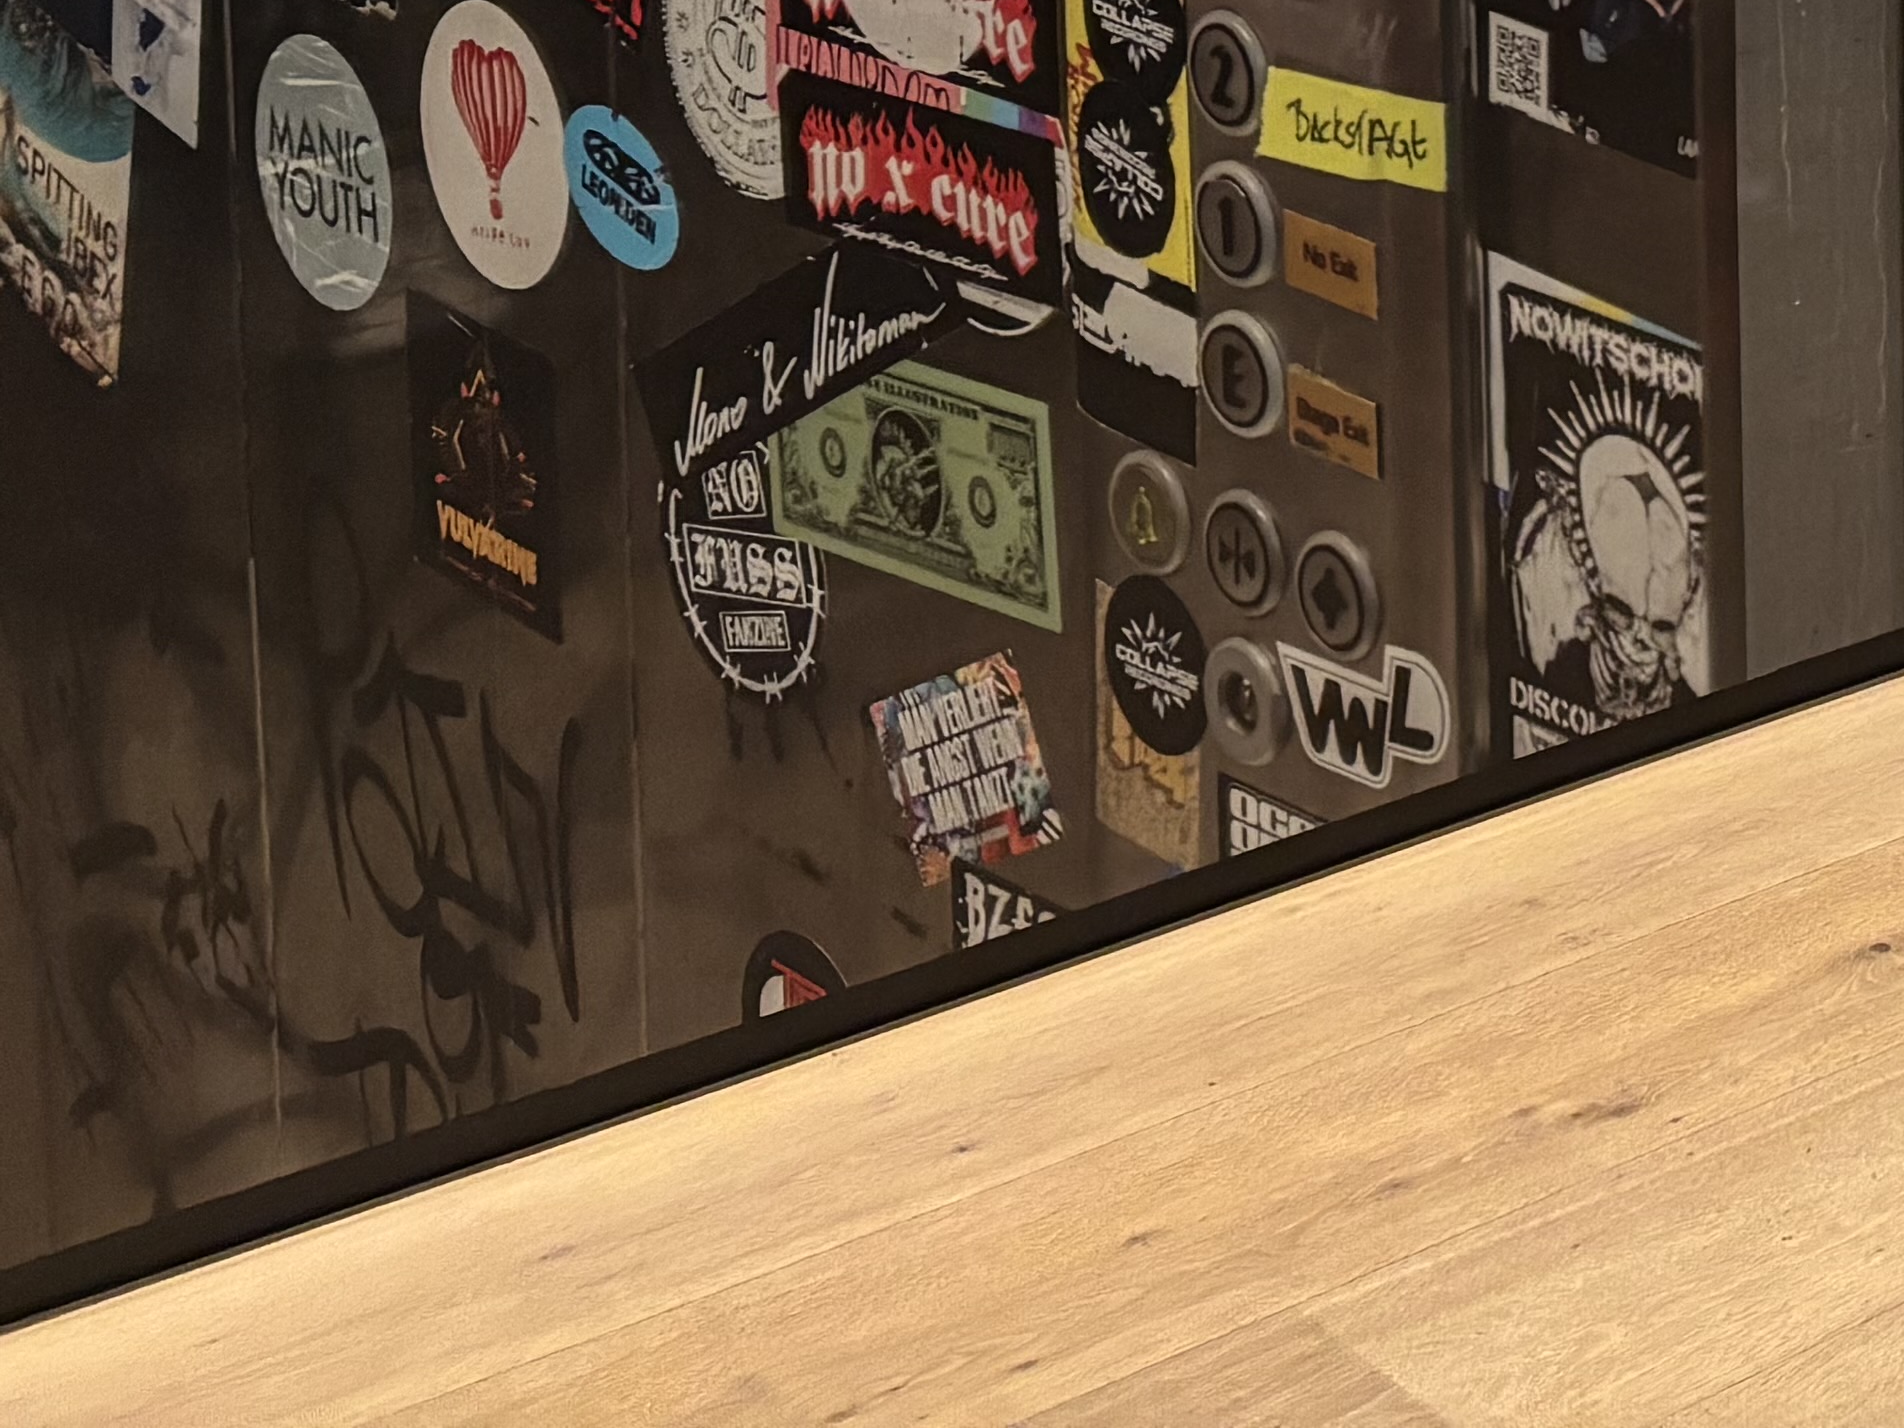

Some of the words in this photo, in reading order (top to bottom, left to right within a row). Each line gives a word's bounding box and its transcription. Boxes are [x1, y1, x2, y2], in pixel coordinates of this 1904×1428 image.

[1210, 46, 1234, 109] 2
[270, 104, 375, 186] MANIC
[16, 135, 118, 262] SPITTING
[271, 156, 381, 245] YOUTH
[690, 531, 804, 602] FUSS
